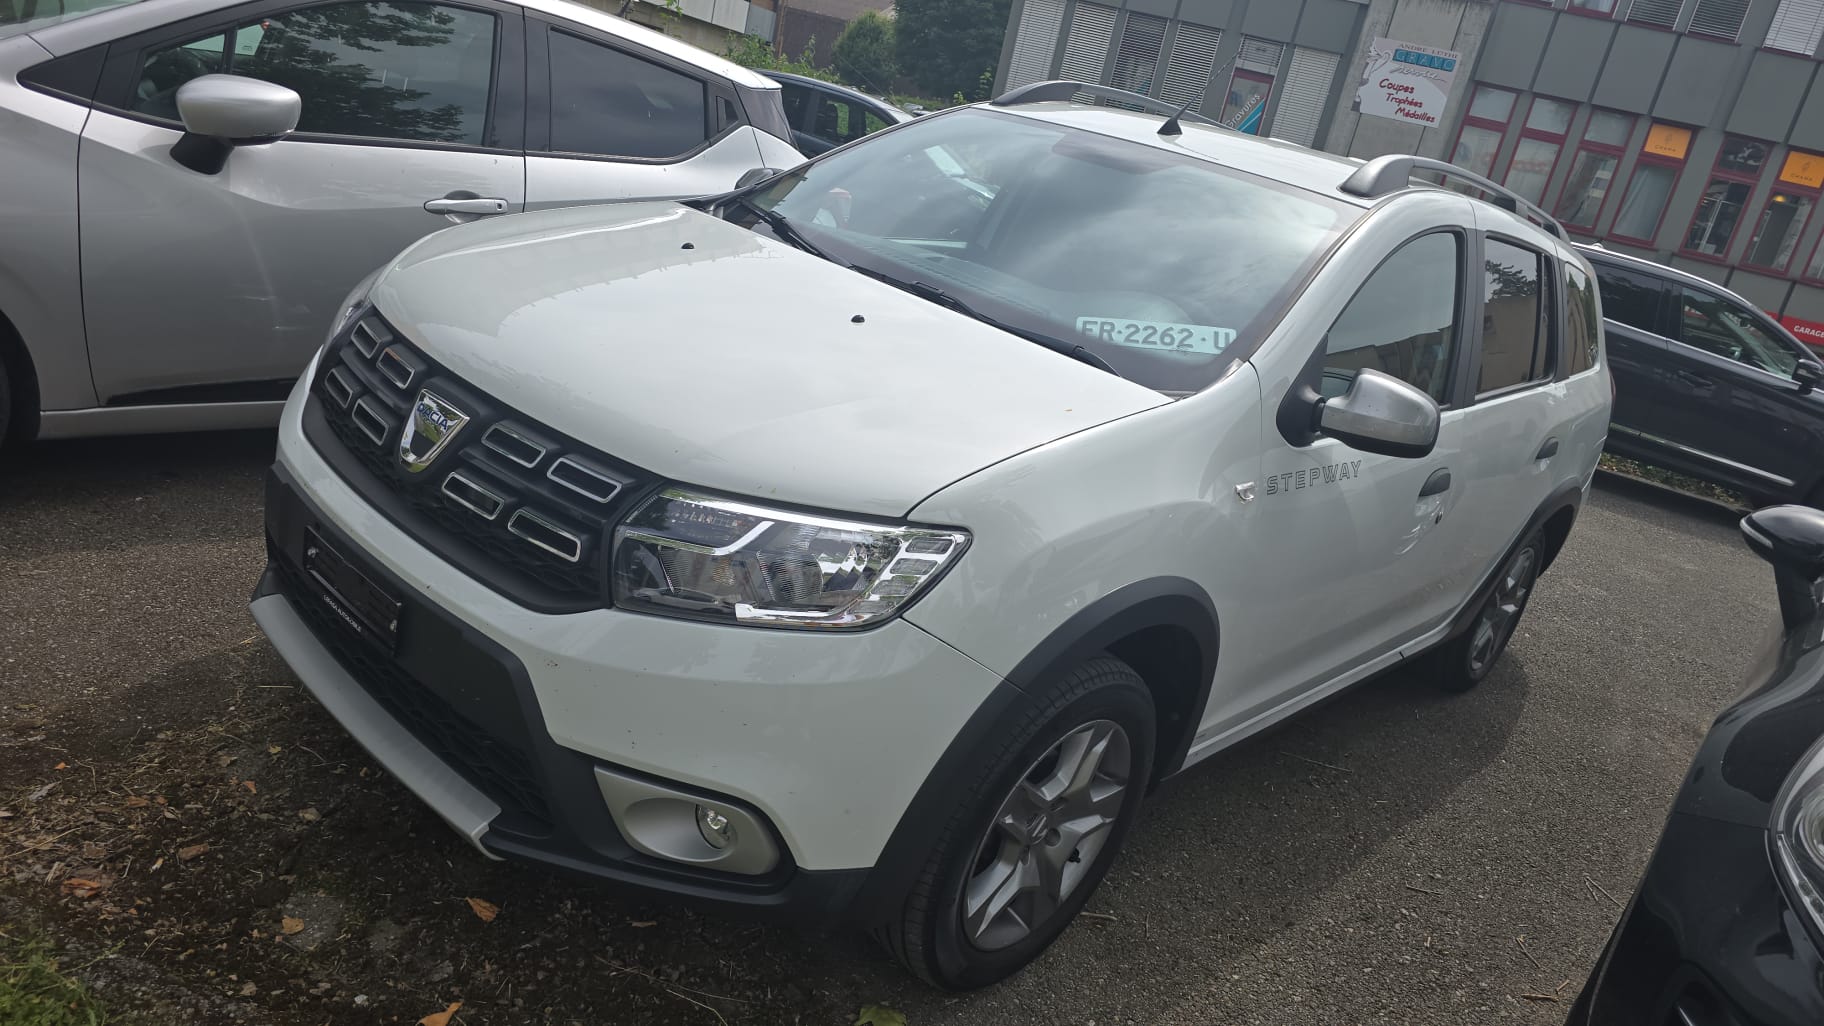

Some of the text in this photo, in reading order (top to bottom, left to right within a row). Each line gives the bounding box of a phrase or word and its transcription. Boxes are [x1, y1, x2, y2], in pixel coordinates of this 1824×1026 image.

[1395, 50, 1455, 71] GRAVO
[1379, 78, 1415, 94] Coupes
[1386, 93, 1423, 108] Trophées
[1395, 107, 1435, 123] Médailles
[416, 402, 449, 431] DACIA
[1266, 459, 1362, 496] STEPWAY
